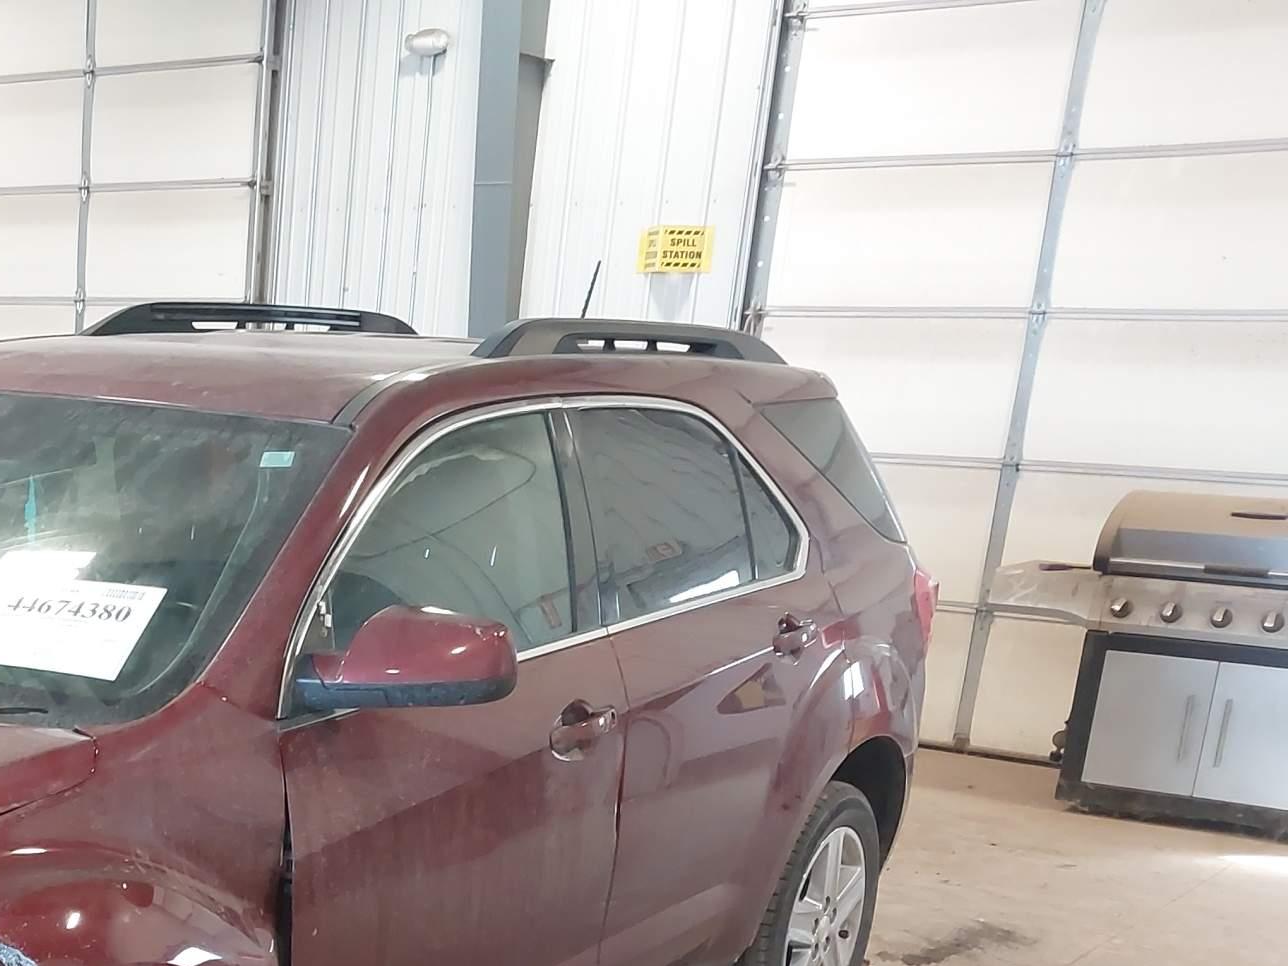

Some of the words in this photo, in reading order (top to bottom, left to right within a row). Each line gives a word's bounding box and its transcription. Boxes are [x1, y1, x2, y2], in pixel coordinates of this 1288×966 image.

[669, 238, 697, 247] SPILL
[661, 250, 702, 260] STATION
[7, 597, 133, 622] 44674380
